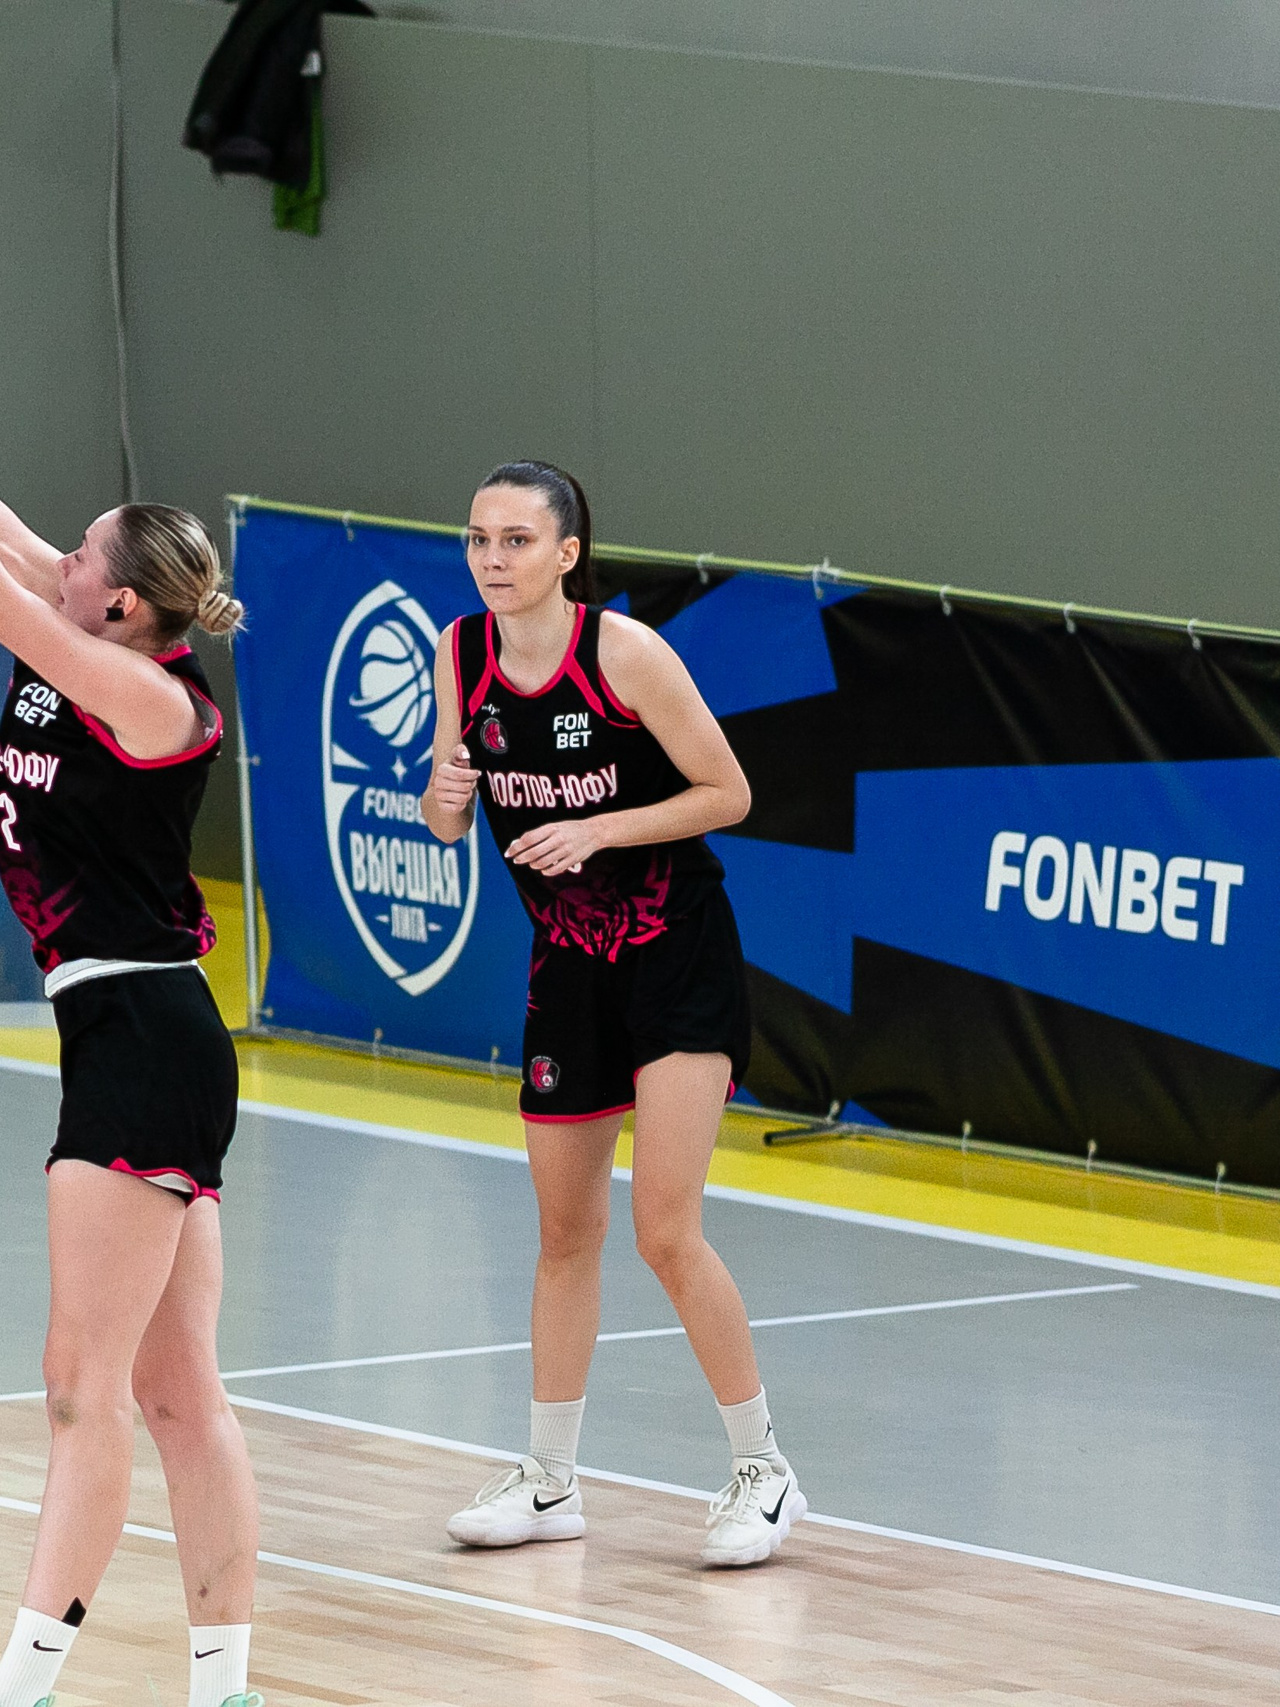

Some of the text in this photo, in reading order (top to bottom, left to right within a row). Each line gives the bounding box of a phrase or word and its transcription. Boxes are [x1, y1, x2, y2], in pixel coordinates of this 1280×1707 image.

[19, 682, 62, 712] FON
[14, 699, 57, 727] BET
[553, 712, 589, 732] FON
[556, 730, 592, 749] BET
[350, 831, 461, 908] ВЫСШАЯ
[985, 831, 1245, 946] FONBET
